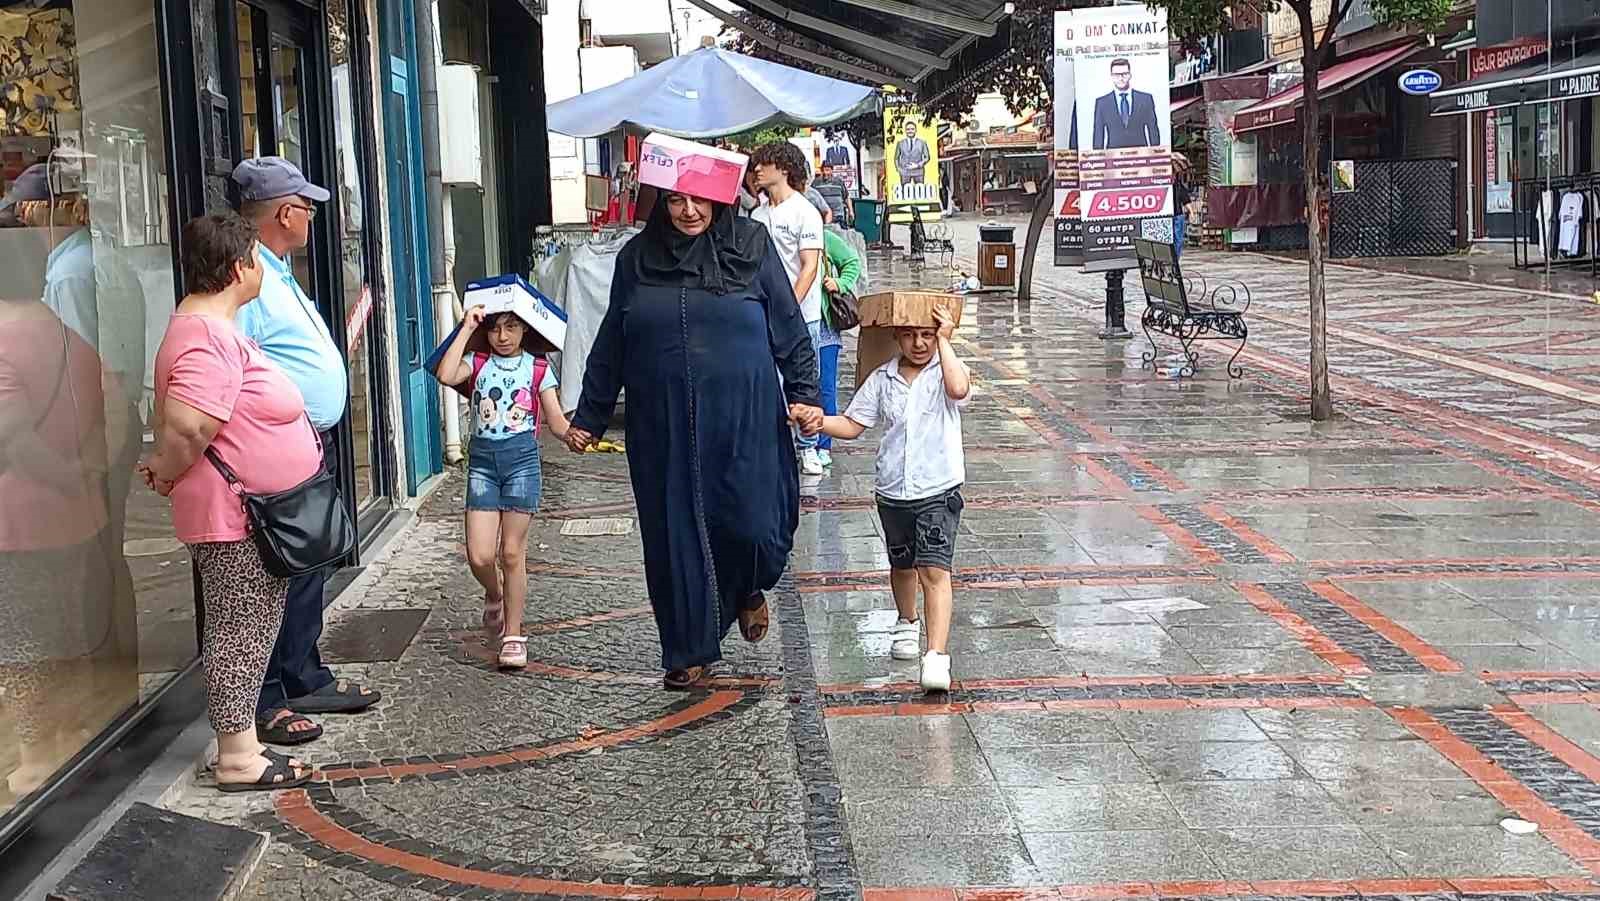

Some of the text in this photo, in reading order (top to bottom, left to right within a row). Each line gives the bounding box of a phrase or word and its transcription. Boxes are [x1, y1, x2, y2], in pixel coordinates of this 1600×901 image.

[1559, 74, 1600, 95] LA PADRE
[1457, 91, 1489, 109] LA PADRE
